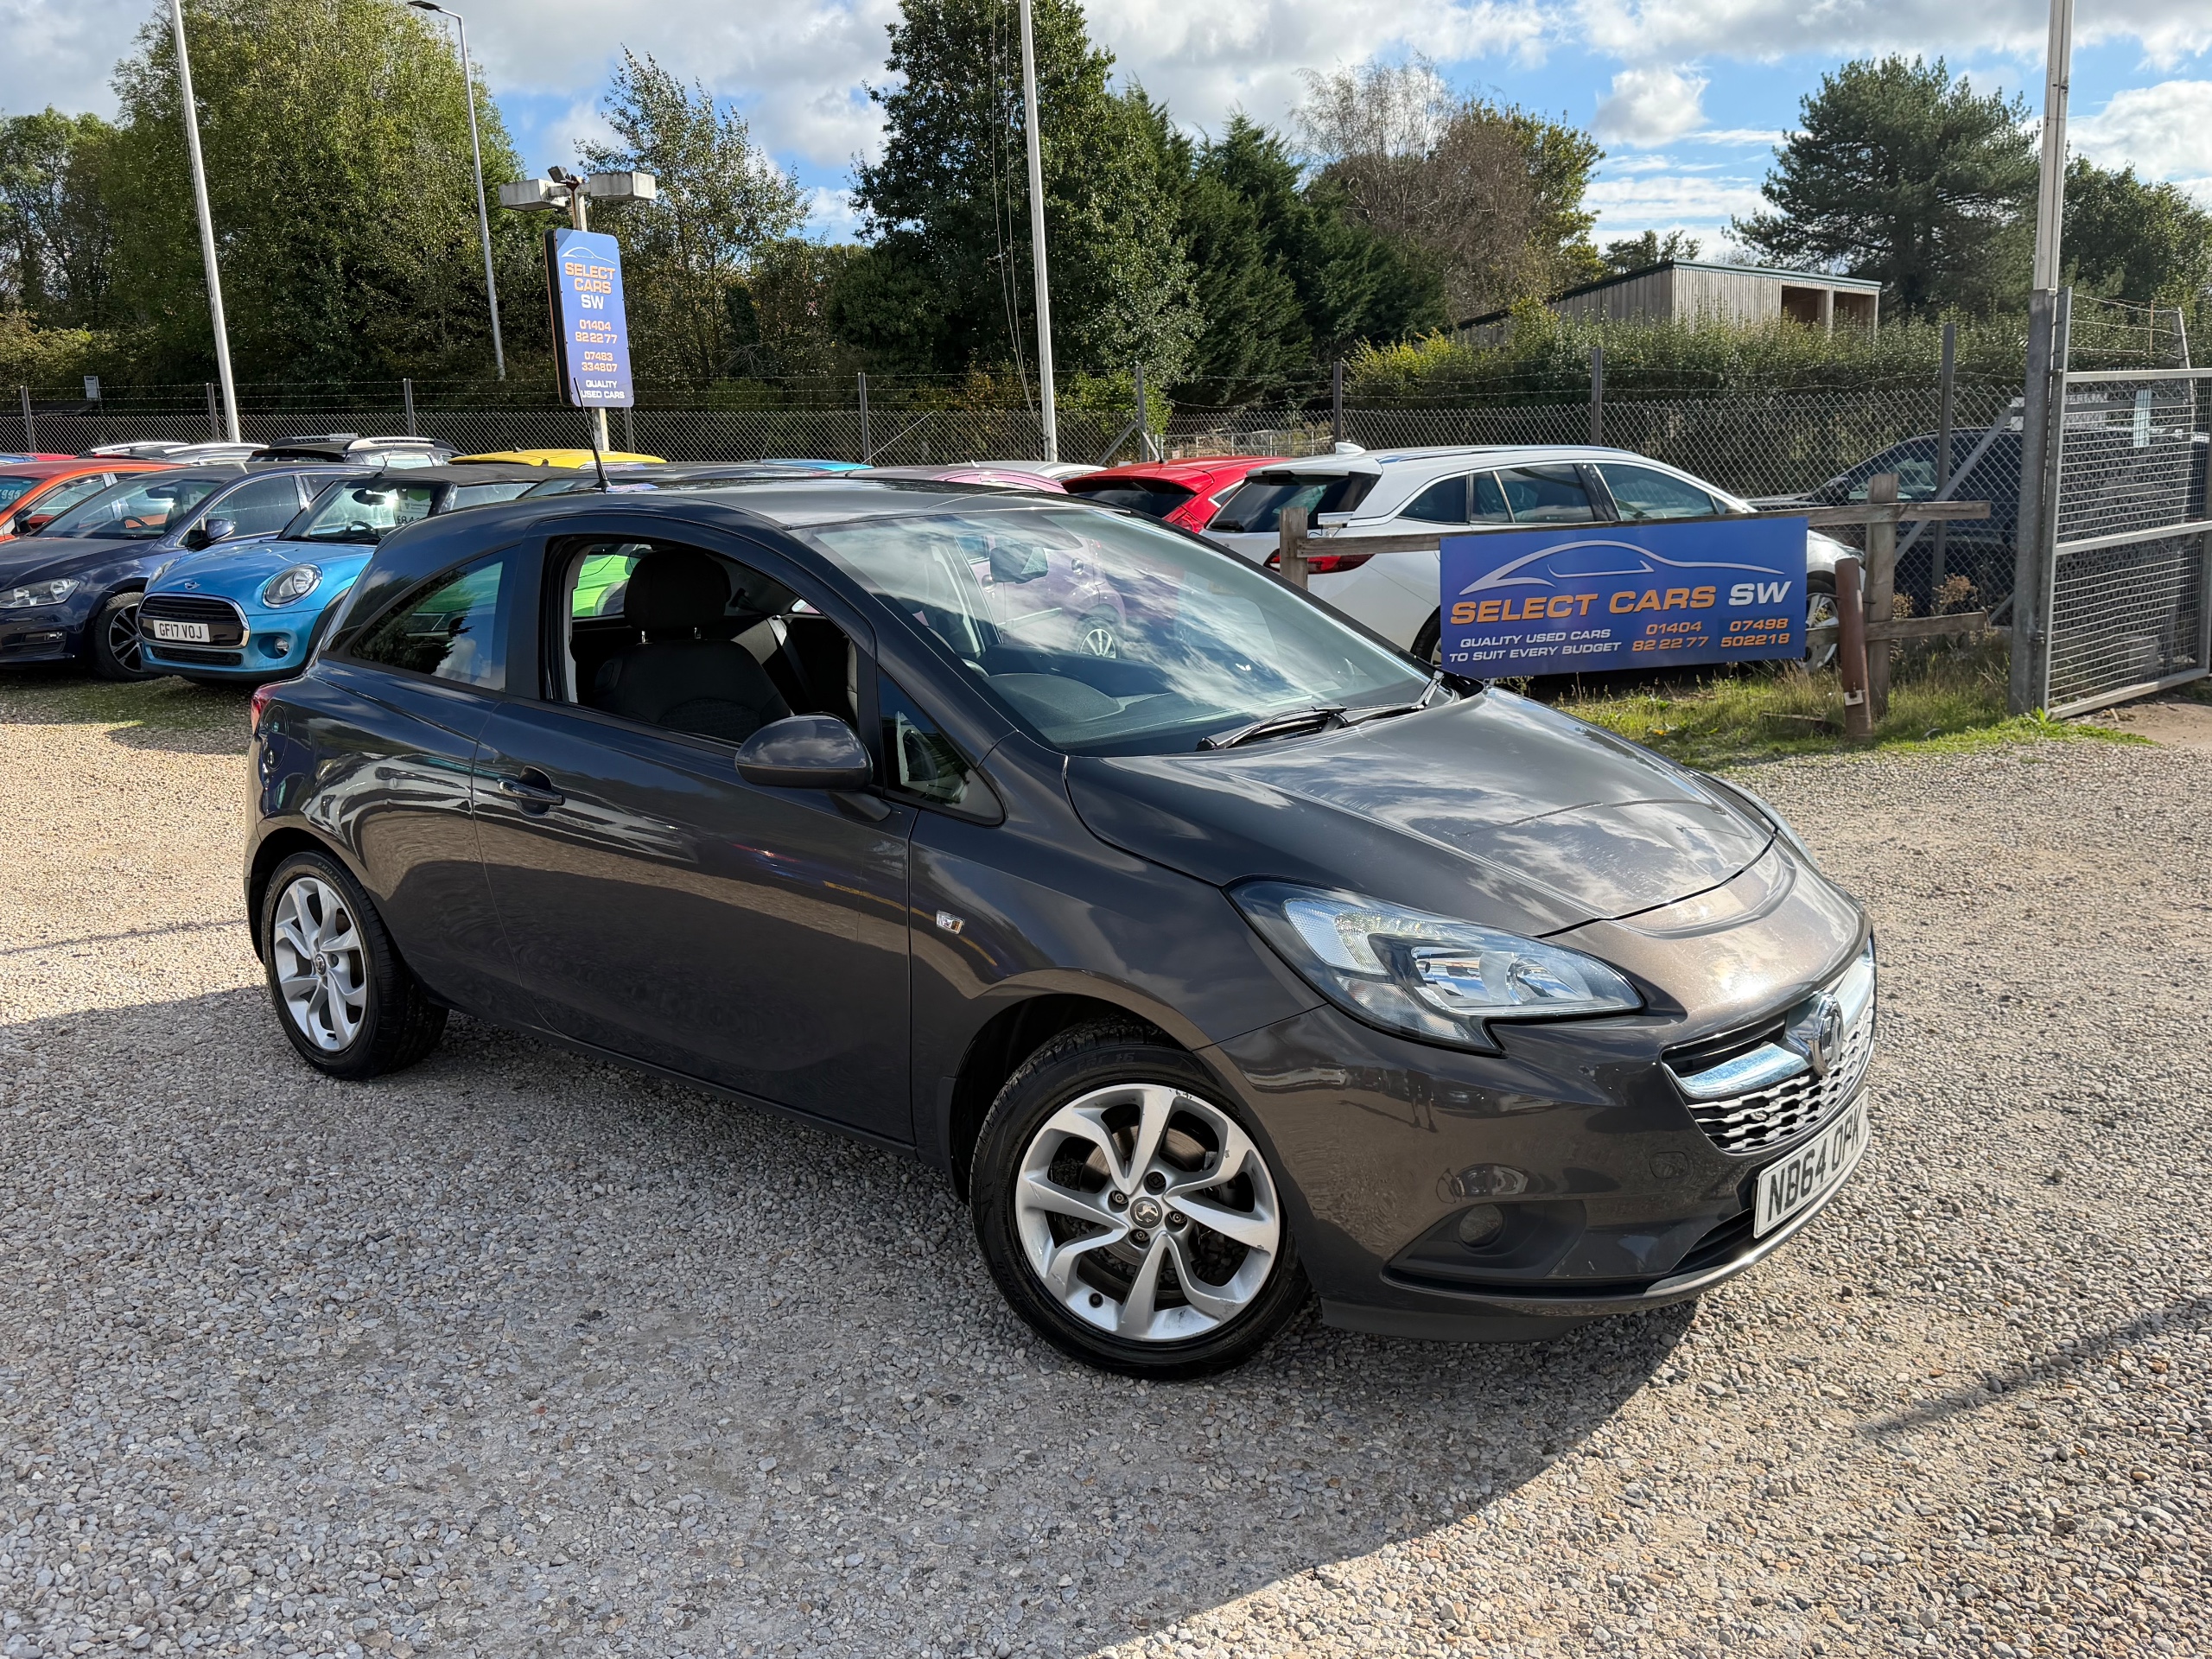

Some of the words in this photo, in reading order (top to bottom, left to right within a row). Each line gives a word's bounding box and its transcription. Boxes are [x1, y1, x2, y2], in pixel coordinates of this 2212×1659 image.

[565, 262, 616, 280] SELECT
[574, 277, 612, 295] CARS
[581, 294, 604, 309] SW
[579, 319, 612, 331] 01404
[585, 379, 618, 389] QUALITY
[580, 390, 602, 398] USED
[603, 391, 625, 399] CARS
[1450, 594, 1599, 625] SELECT
[1609, 585, 1716, 614] CARS
[1728, 581, 1792, 606] SW
[159, 622, 179, 638] GF17
[181, 625, 202, 639] VOJ
[1645, 620, 1702, 636] 01404
[1729, 618, 1789, 632] 07498
[1459, 634, 1522, 648] QUALITY
[1525, 632, 1567, 644] USED
[1570, 628, 1611, 641] CARS
[1719, 632, 1790, 648] 502218
[1449, 652, 1469, 663] TO
[1472, 650, 1506, 661] SUIT
[1509, 646, 1559, 658] EVERY
[1561, 642, 1622, 655] BUDGET
[1832, 1102, 1863, 1173] OPK
